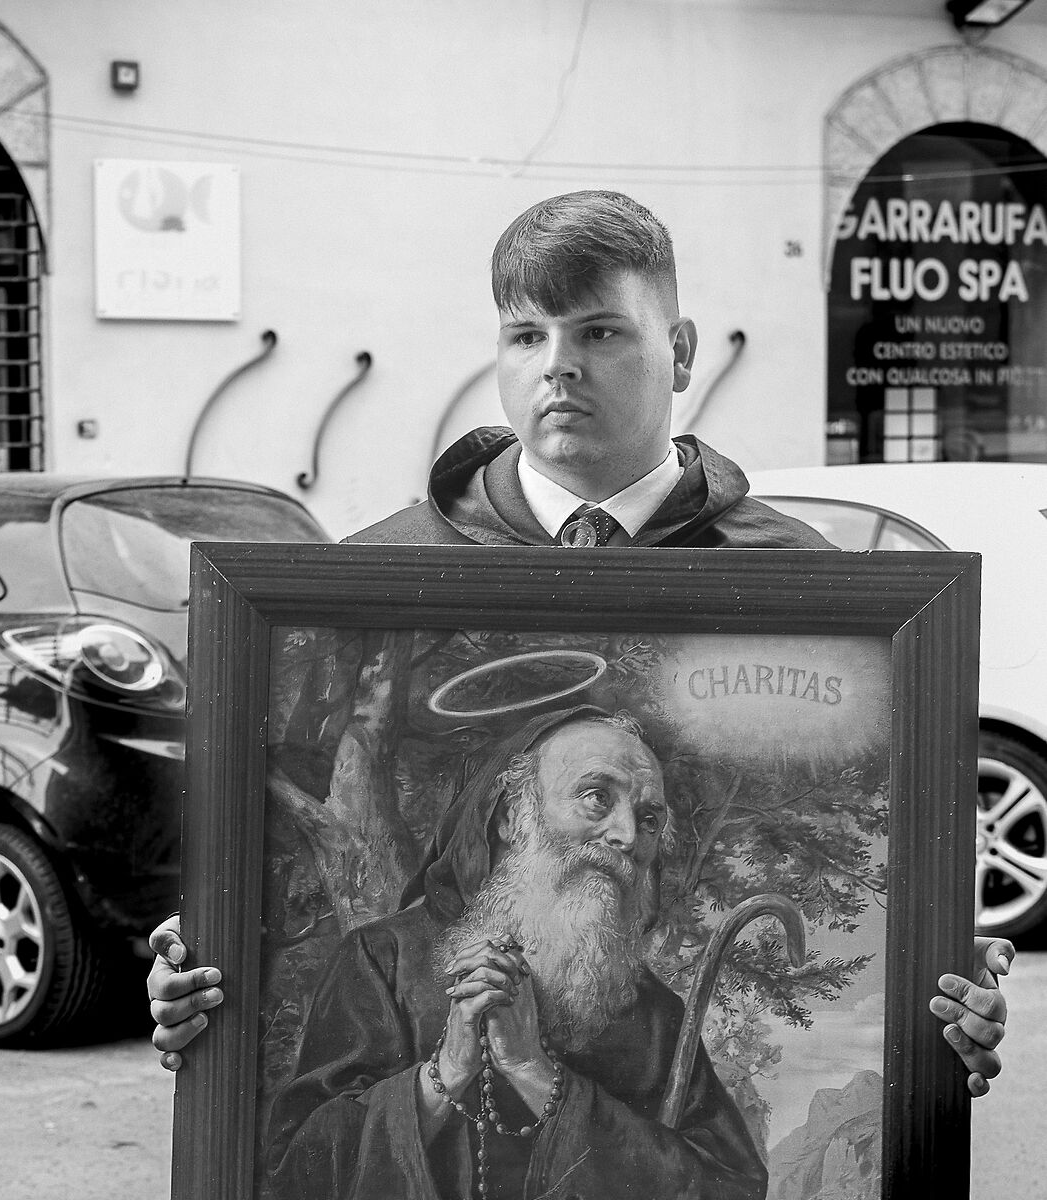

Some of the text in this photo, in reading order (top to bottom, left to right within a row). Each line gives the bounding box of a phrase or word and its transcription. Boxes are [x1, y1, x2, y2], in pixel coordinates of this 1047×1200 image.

[850, 257, 1030, 302] FLUO SPA
[894, 315, 985, 334] UN NUOVO
[873, 341, 1009, 360] CENTRO ESTETICO
[846, 367, 884, 386] CON
[886, 367, 971, 386] QUALCOSA
[974, 367, 994, 386] IN
[687, 663, 843, 706] CHARITAS
